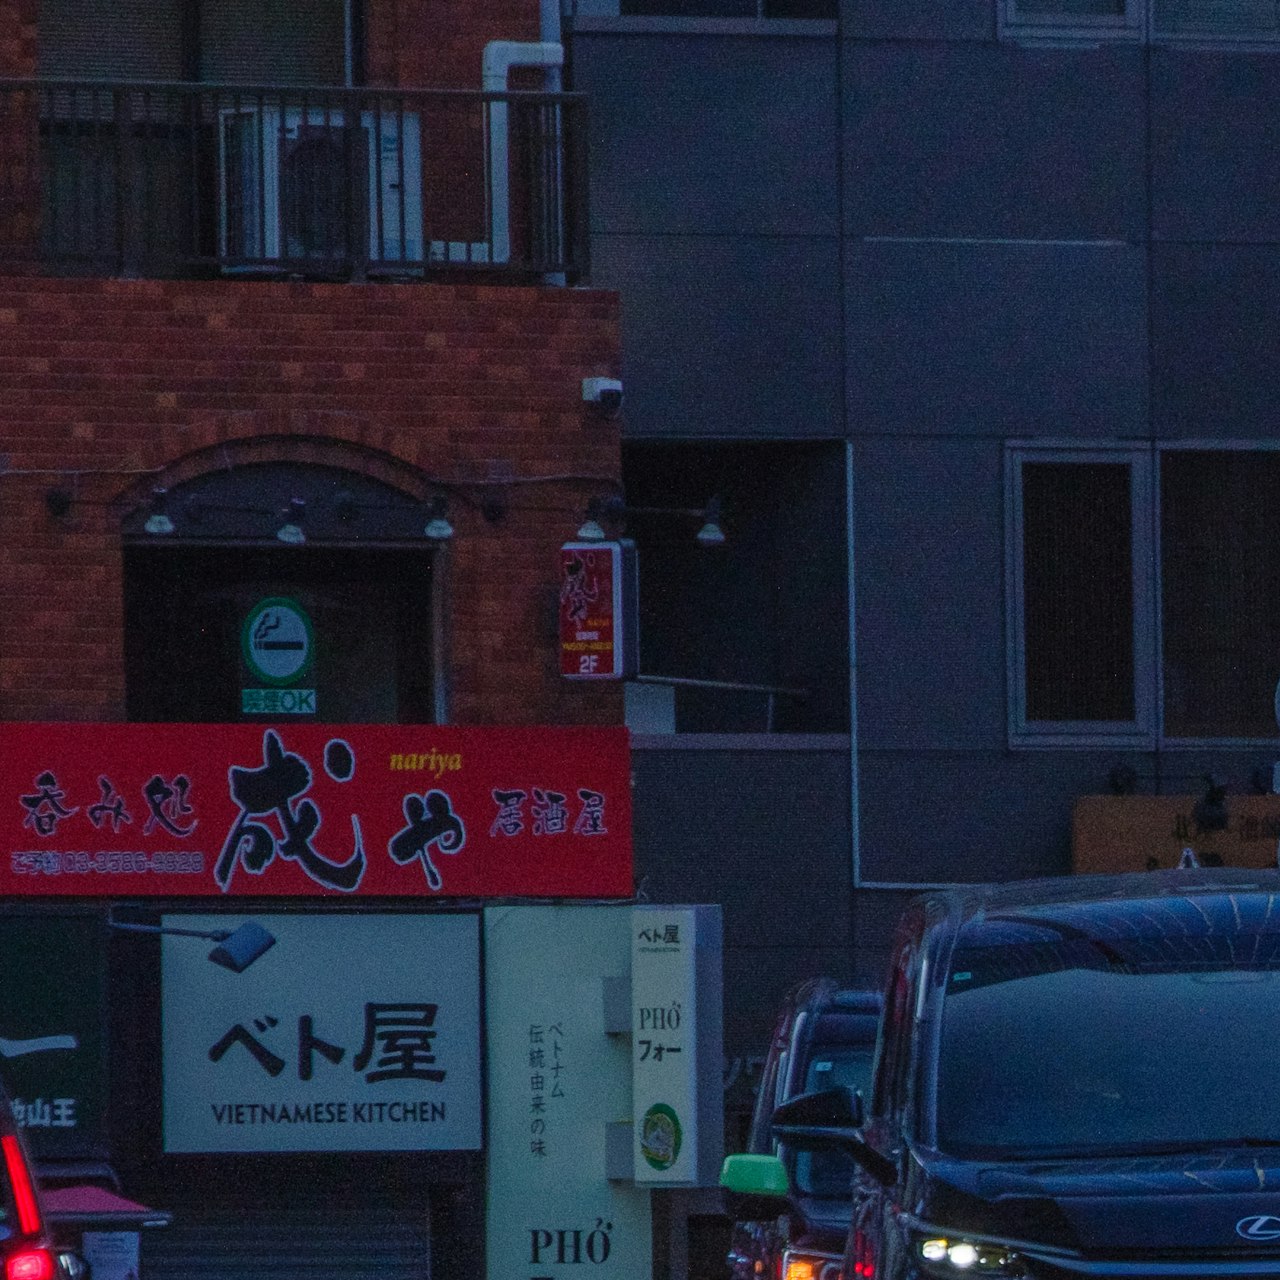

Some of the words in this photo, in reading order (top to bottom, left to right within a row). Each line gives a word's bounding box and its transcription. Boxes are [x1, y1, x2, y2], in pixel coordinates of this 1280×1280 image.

[579, 654, 600, 674] 2F
[389, 747, 464, 778] nariya
[19, 769, 200, 839] 呑み処
[488, 787, 609, 838] 居酒屋
[638, 924, 681, 945] ベト屋
[208, 1002, 447, 1084] ベト屋
[548, 1021, 565, 1099] ベトナム
[638, 1039, 682, 1062] フォー
[528, 1024, 547, 1157] 伝統由来の味
[211, 1102, 348, 1125] VIETNAMESE
[353, 1101, 447, 1123] KITCHEN
